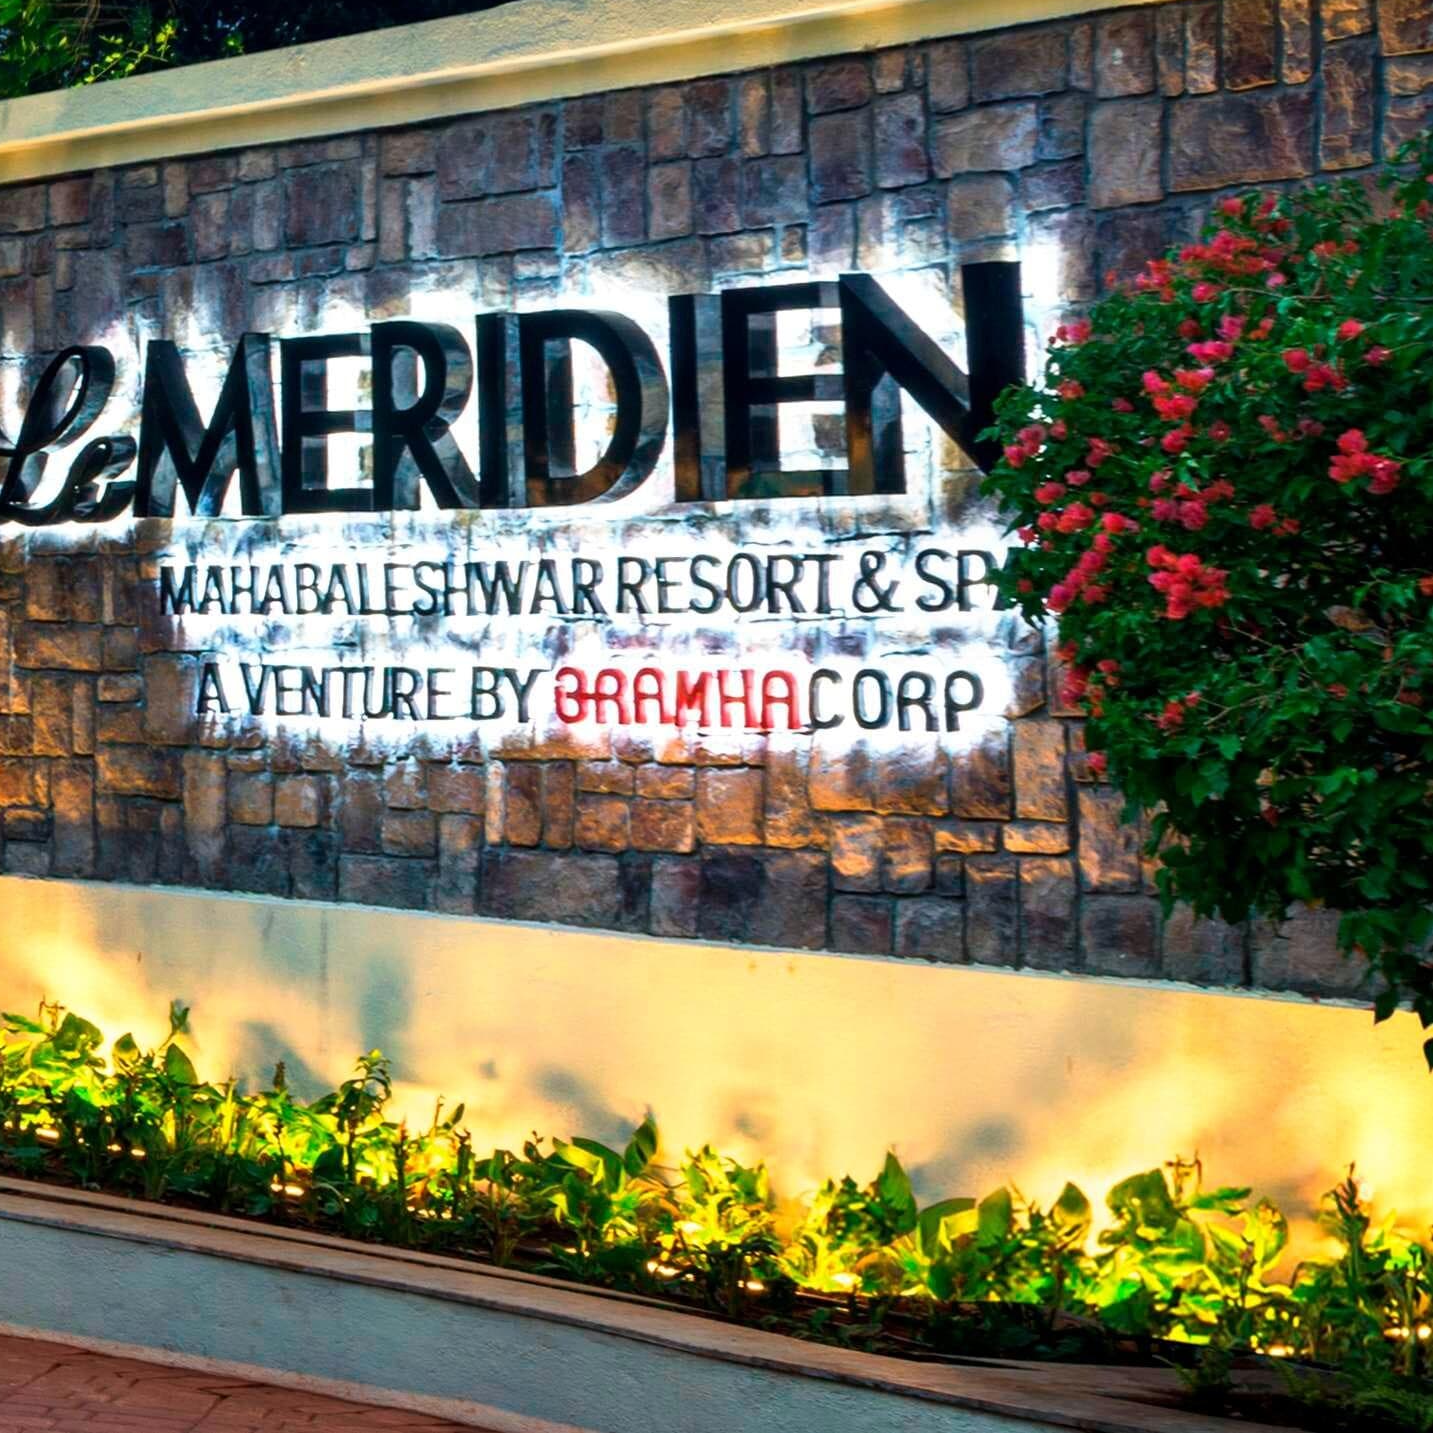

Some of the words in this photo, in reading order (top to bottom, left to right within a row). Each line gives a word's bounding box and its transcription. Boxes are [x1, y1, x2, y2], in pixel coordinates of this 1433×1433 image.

[133, 261, 1026, 518] MERIDIEN
[160, 559, 608, 616] MAHABALESHWAR
[616, 552, 844, 615] RESORT
[851, 550, 904, 613] &
[196, 663, 230, 714] A
[239, 664, 456, 721] VENTURE
[471, 667, 552, 723] BY
